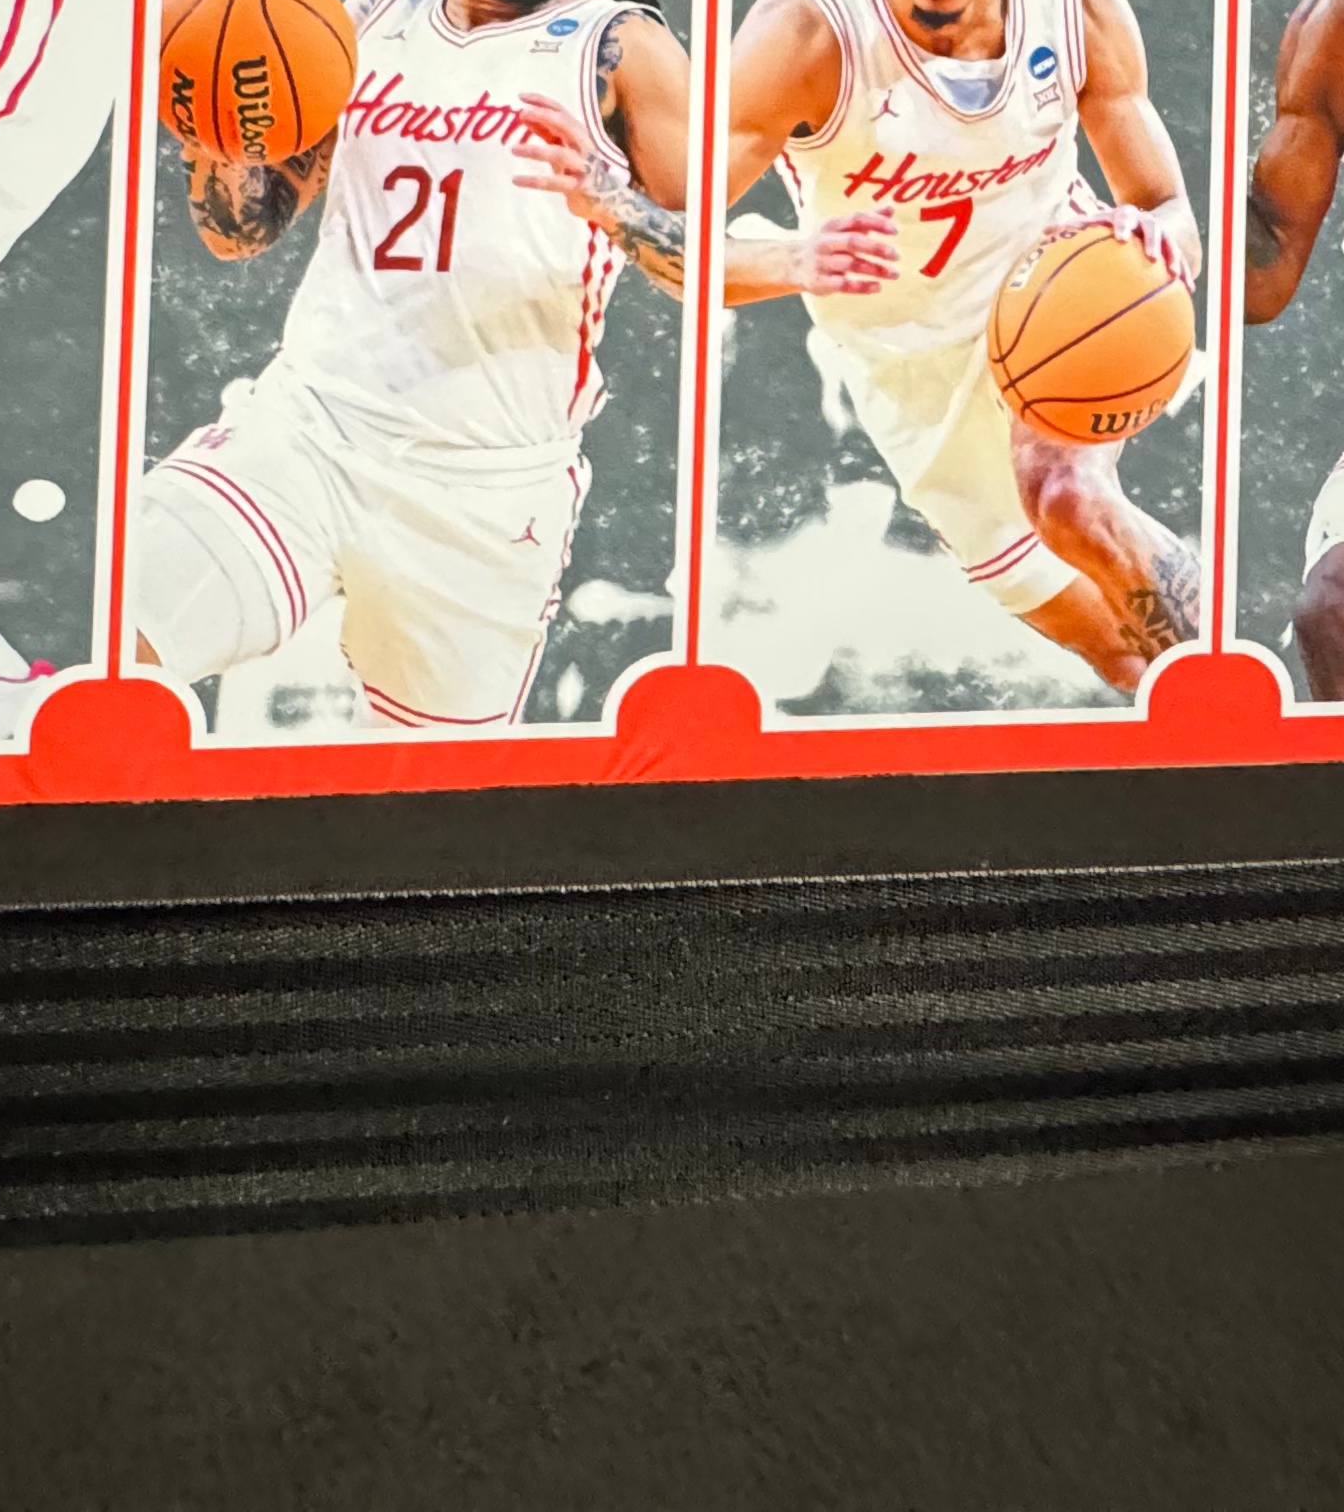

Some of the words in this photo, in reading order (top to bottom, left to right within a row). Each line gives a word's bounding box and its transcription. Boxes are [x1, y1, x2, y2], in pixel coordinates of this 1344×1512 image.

[843, 138, 1057, 203] Houston
[374, 165, 464, 272] 21
[919, 196, 973, 279] 7
